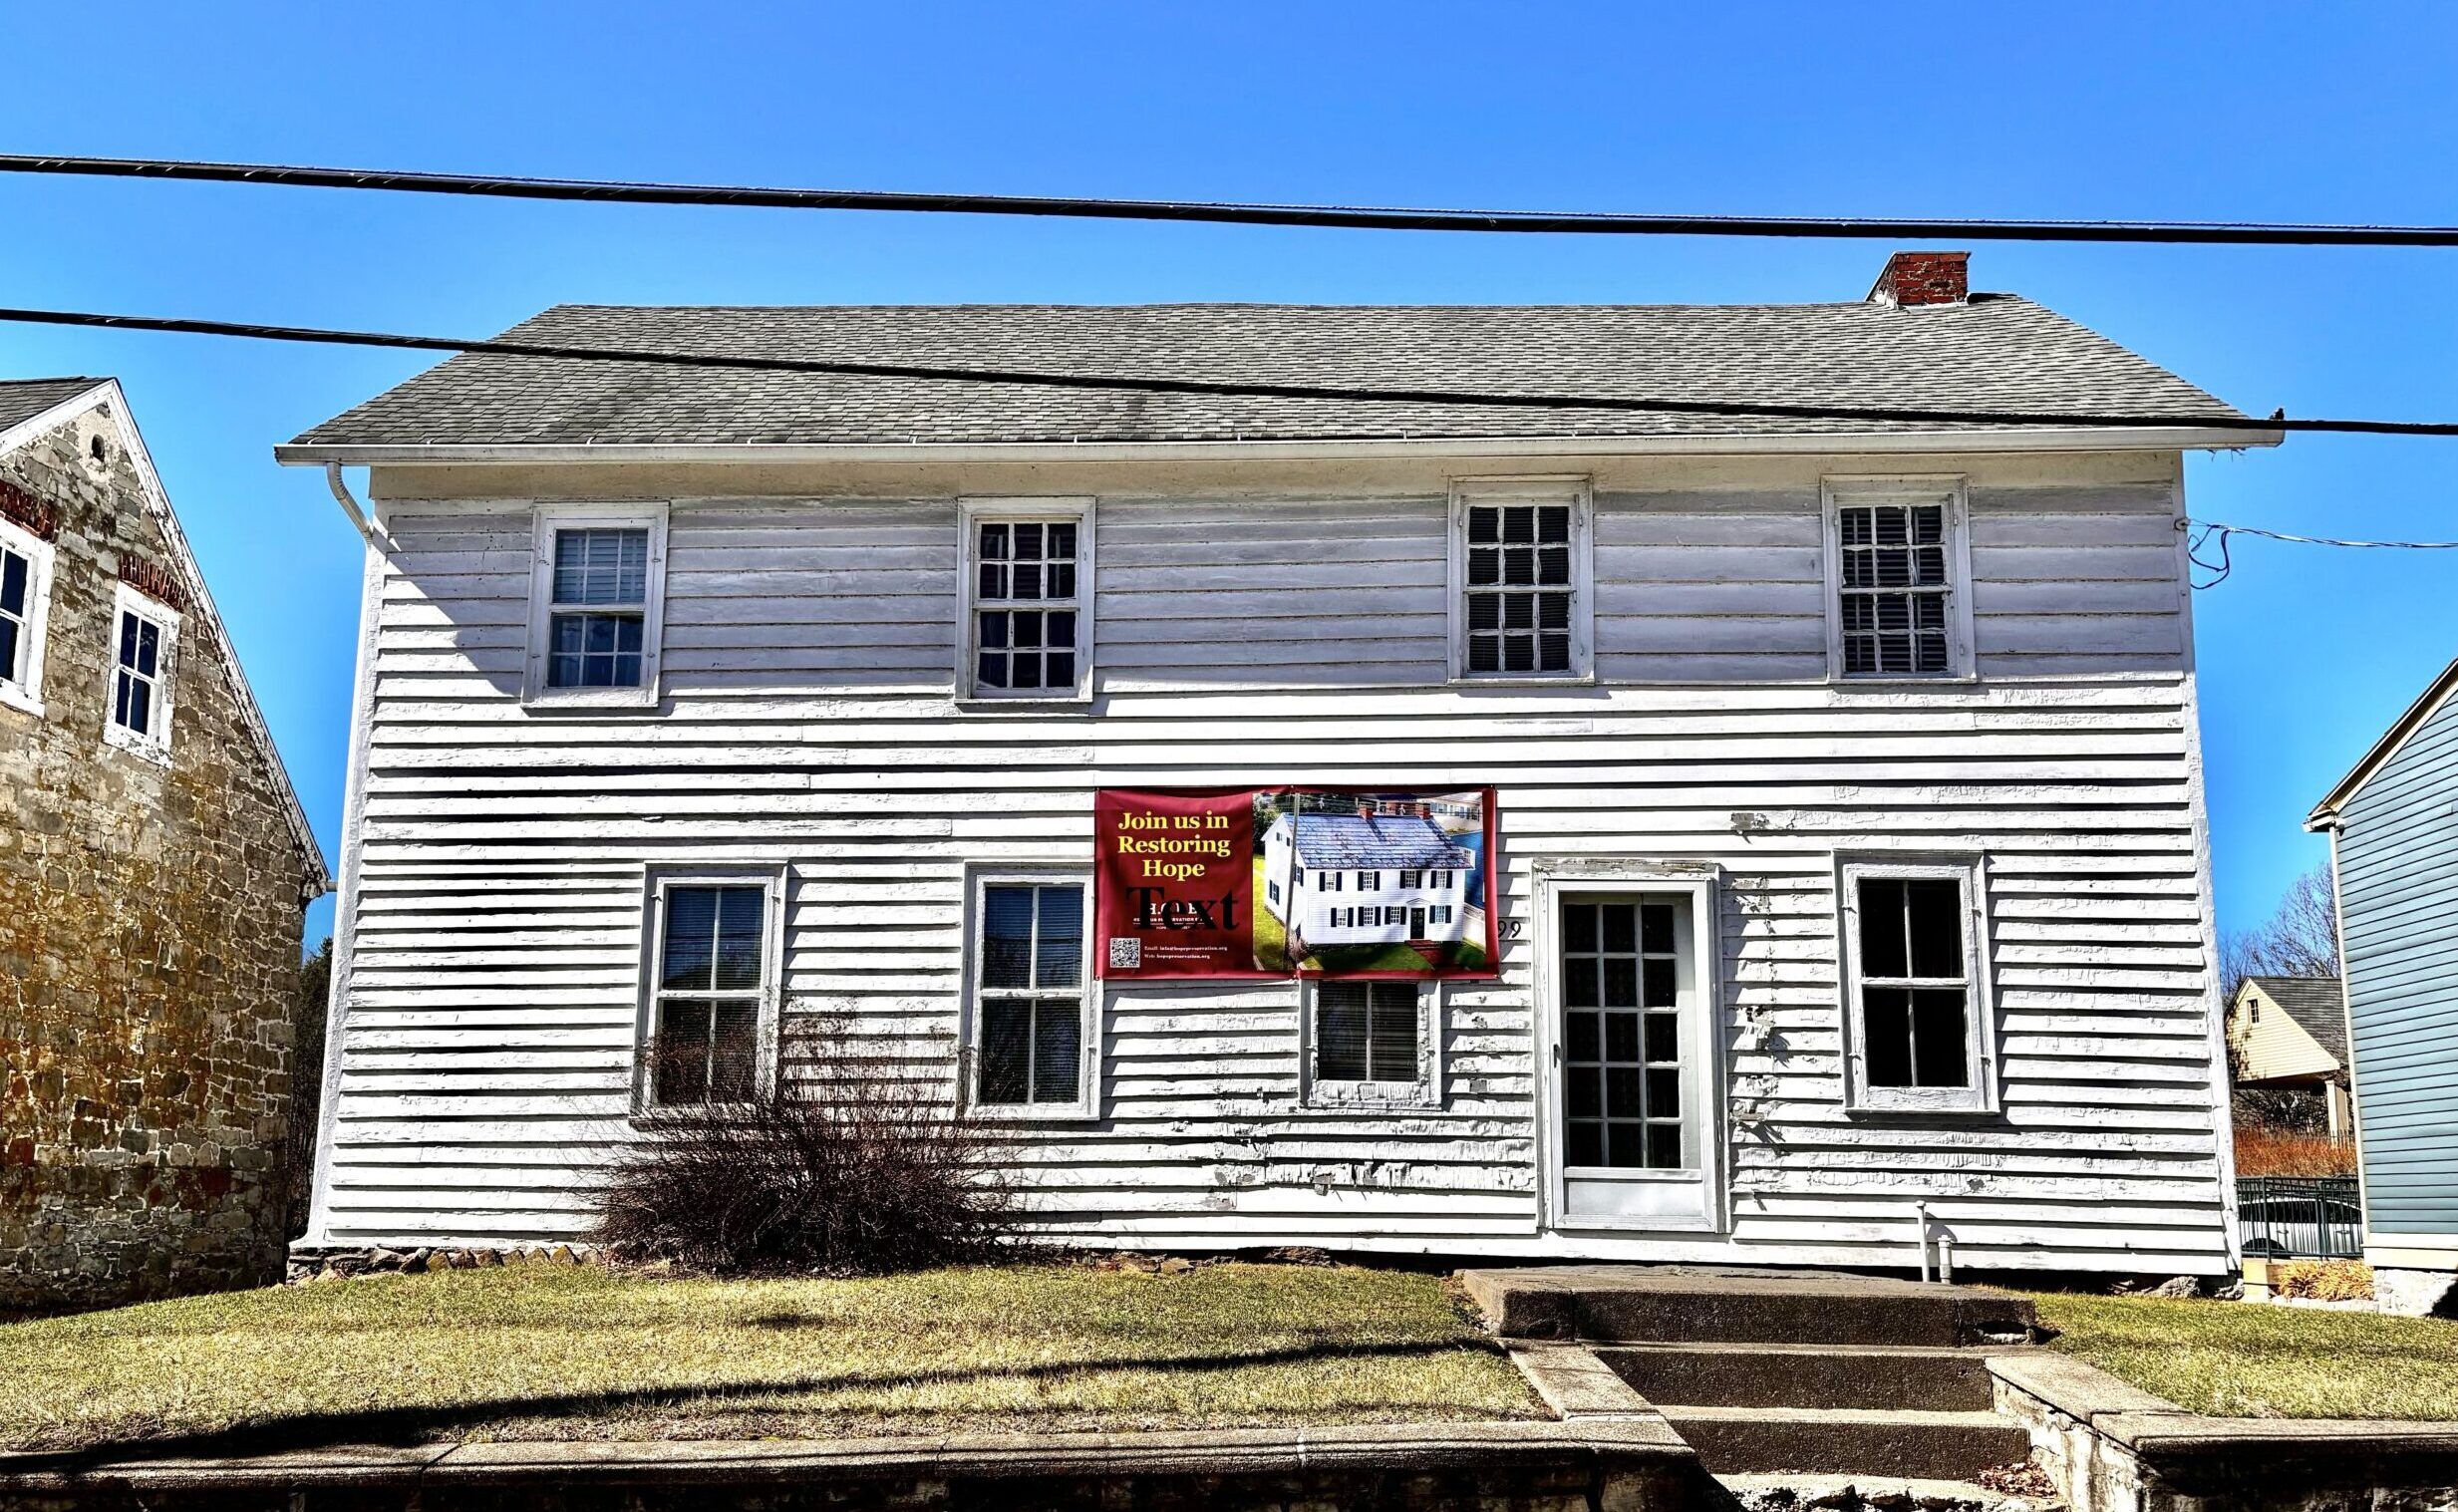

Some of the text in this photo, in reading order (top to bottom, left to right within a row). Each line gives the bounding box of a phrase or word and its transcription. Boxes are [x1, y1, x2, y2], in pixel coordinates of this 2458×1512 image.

[1117, 809, 1230, 829] Join us in
[1117, 833, 1231, 857] Restoring
[1141, 859, 1206, 882] Hope
